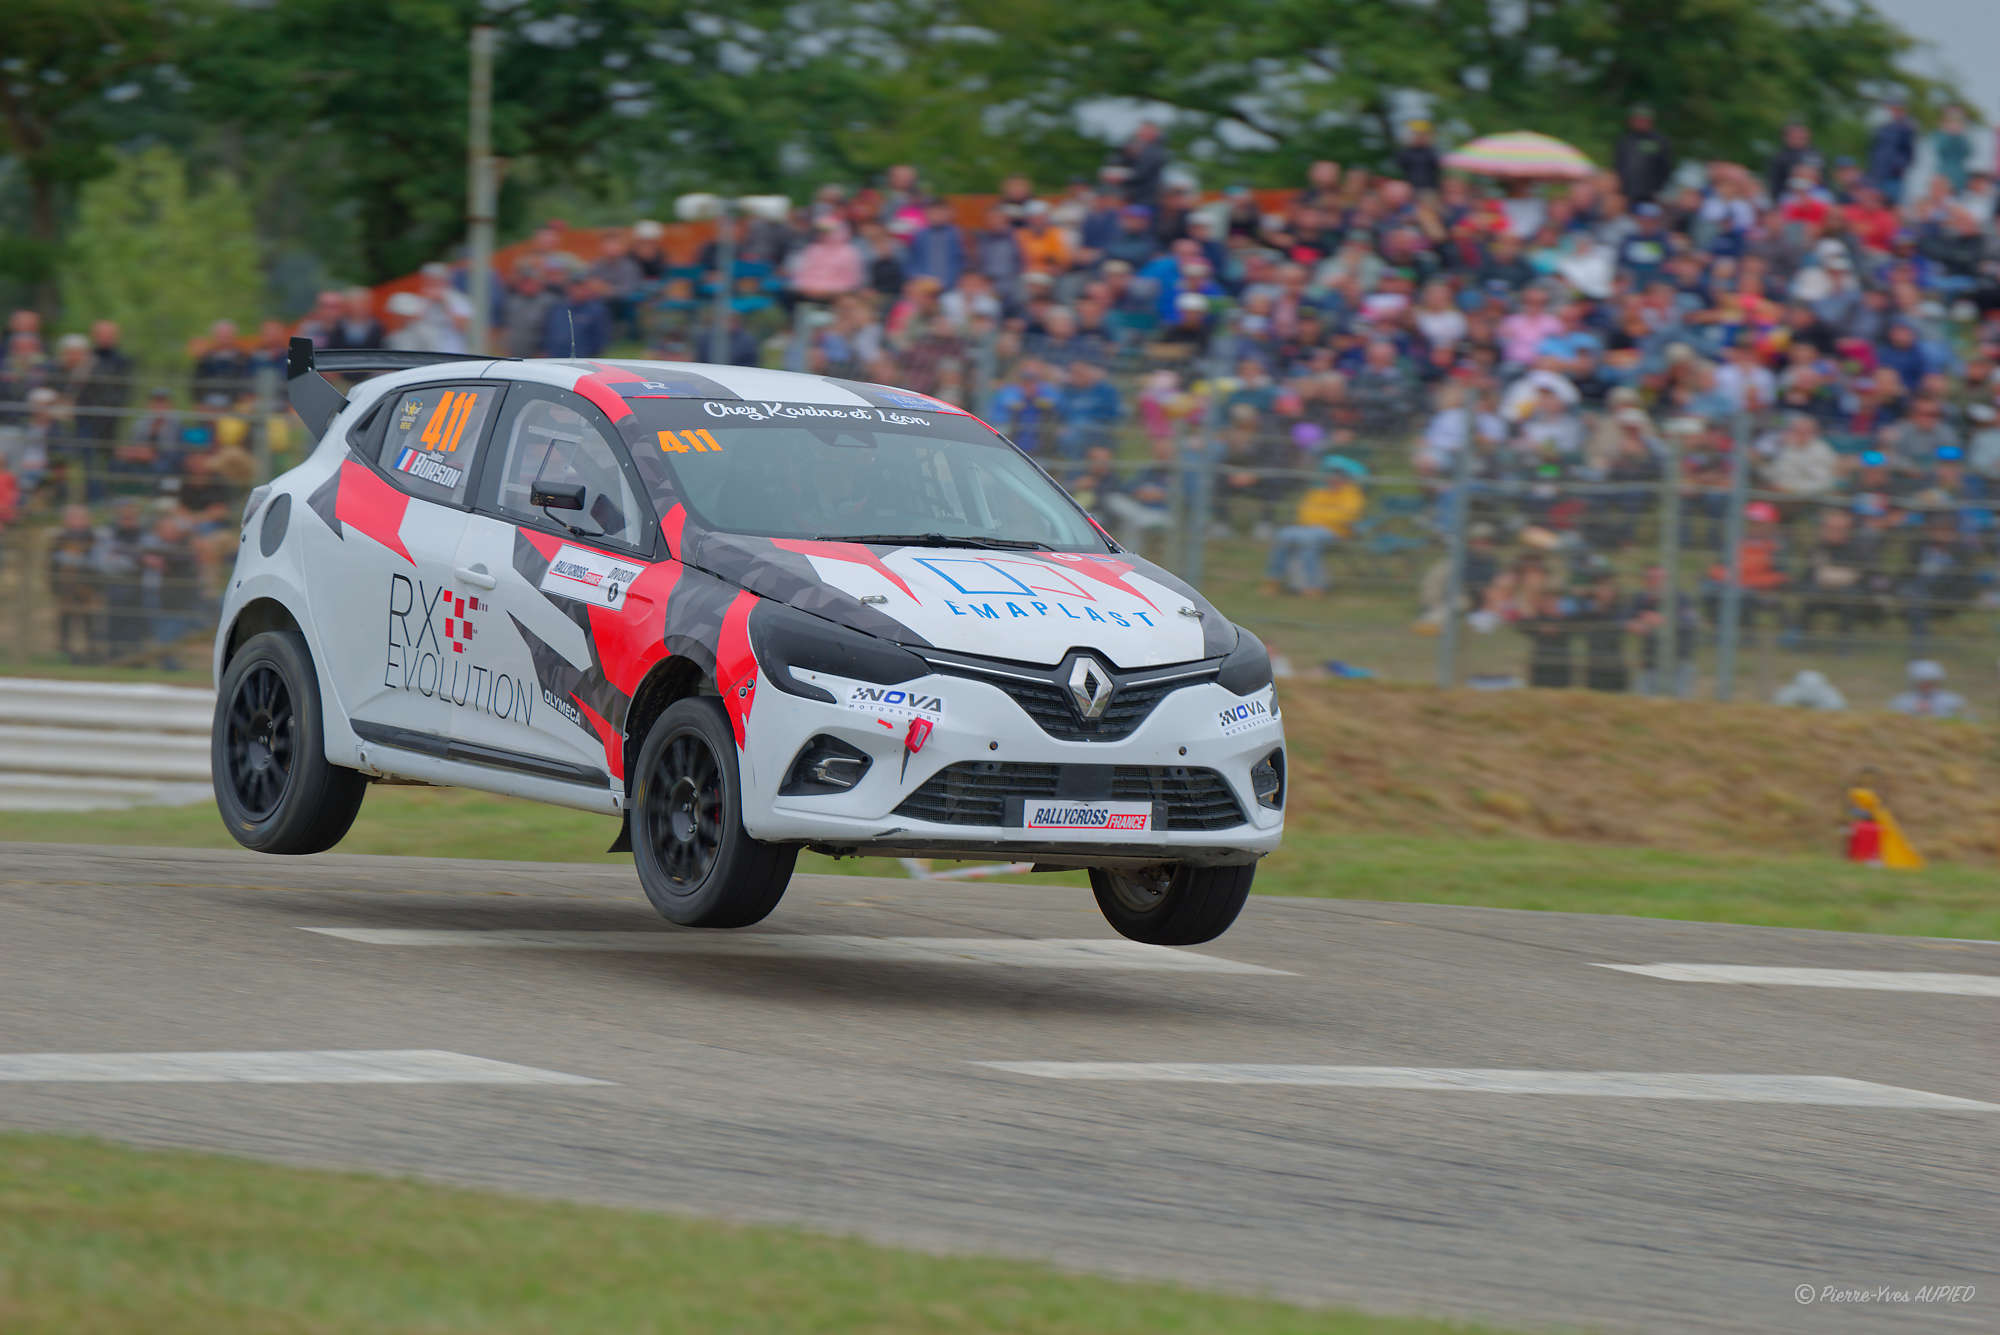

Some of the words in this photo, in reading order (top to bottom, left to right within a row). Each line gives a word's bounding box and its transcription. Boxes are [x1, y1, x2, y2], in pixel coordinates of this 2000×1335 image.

[420, 391, 478, 452] 411
[703, 401, 768, 421] Chez
[762, 402, 847, 419] Karine
[850, 408, 872, 420] et
[875, 409, 930, 426] Léon
[657, 428, 723, 453] 411
[552, 560, 590, 579] RALLYCROSS
[388, 573, 443, 655] RX
[944, 600, 1154, 627] EMAPLAST
[384, 642, 533, 727] EVOLUTION
[852, 687, 942, 712] NOVA
[1220, 700, 1267, 726] NOVA
[1033, 808, 1108, 824] RALLYCROSS
[1108, 815, 1145, 829] FRANCE
